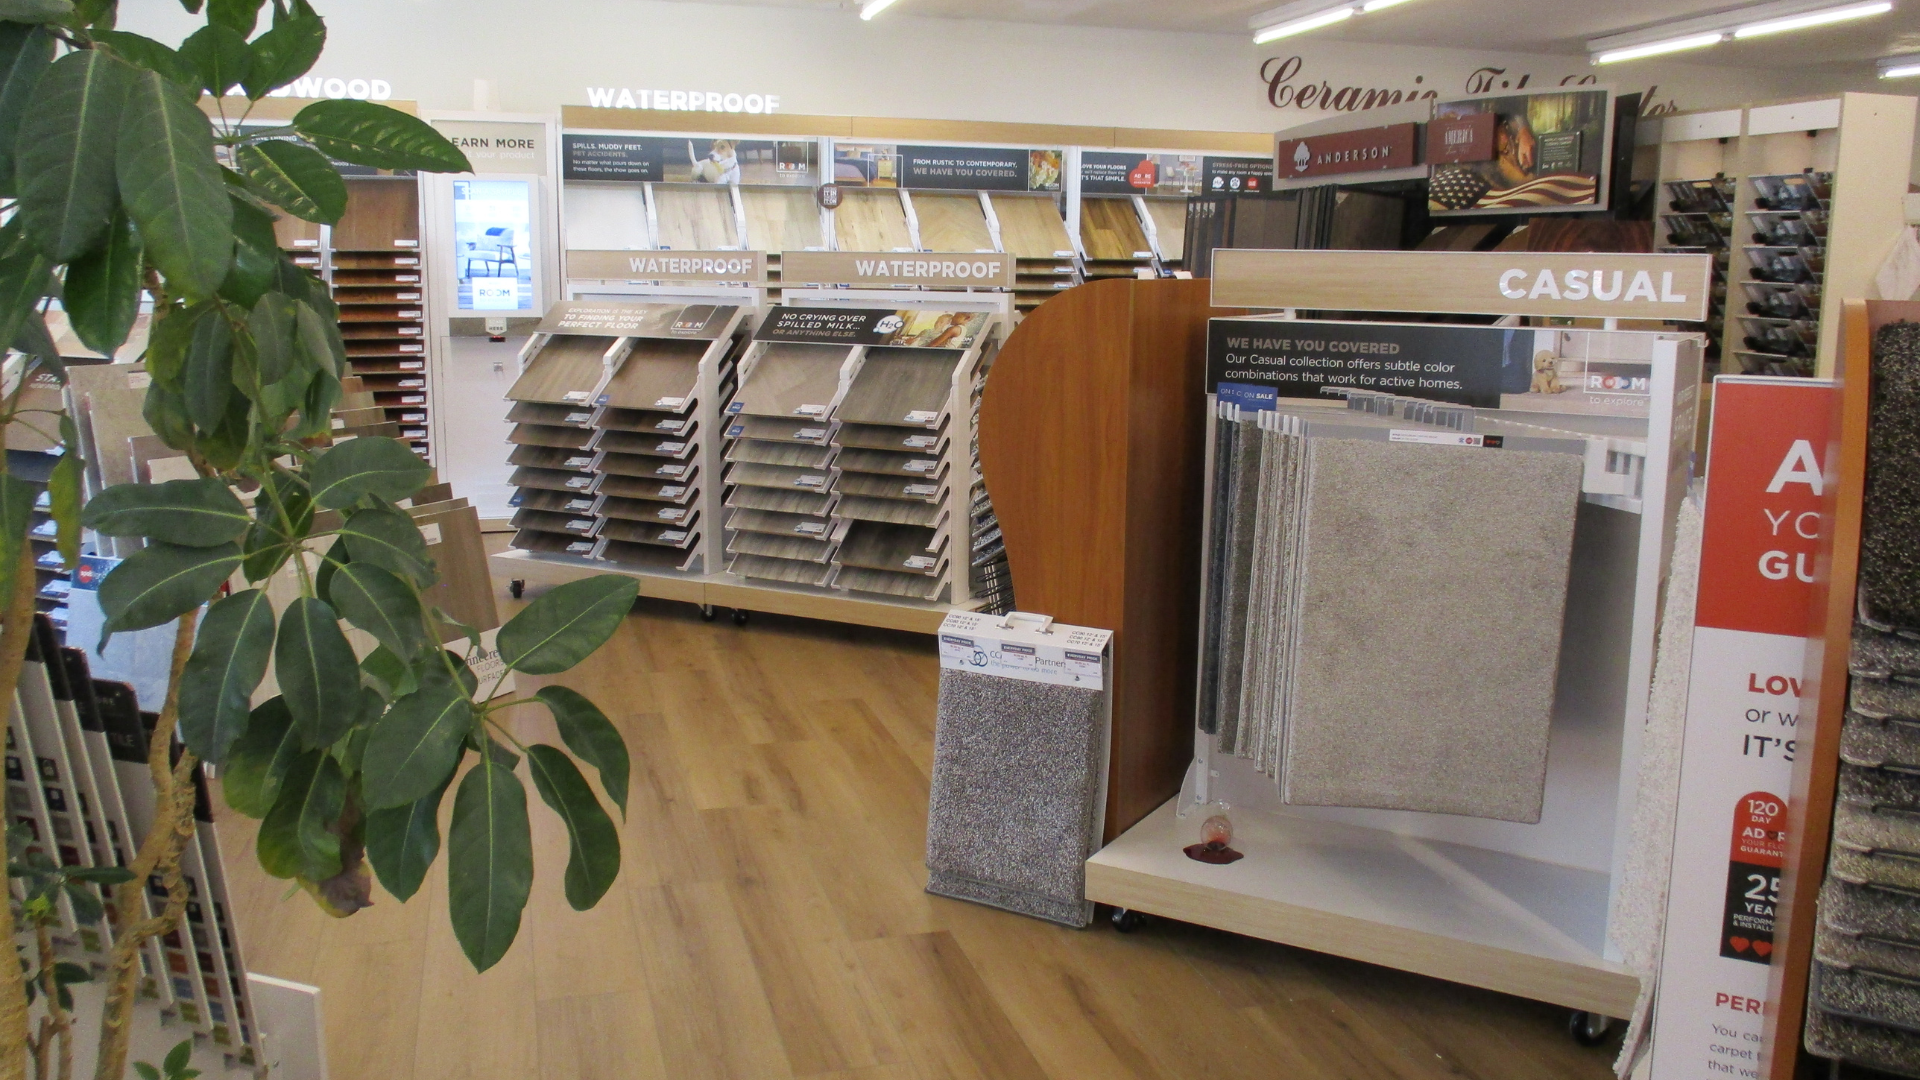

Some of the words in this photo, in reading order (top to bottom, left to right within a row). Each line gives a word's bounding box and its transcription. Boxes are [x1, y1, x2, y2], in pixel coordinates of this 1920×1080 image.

[203, 77, 392, 100] ADWOOD
[587, 87, 780, 114] WATERPROOF
[452, 137, 489, 147] EARN
[496, 139, 535, 149] MORE
[476, 152, 497, 160] your
[501, 152, 535, 160] product
[1317, 146, 1389, 165] ANDERSON
[966, 160, 1018, 168] CONTEMPORARY,
[913, 167, 928, 175] WE
[955, 168, 973, 176] YOU
[975, 170, 1018, 178] COVERED.
[629, 257, 753, 274] WATERPROOF
[855, 260, 1000, 278] WATERPROOF
[1499, 268, 1687, 303] CASUAL
[557, 321, 602, 329] PERFECT
[604, 321, 639, 330] FLOOR
[618, 315, 644, 323] YOUR
[777, 320, 822, 329] SPILLED
[827, 321, 861, 330] MILK...
[799, 314, 836, 322] CRYING
[838, 315, 867, 323] OVER
[1227, 337, 1249, 349] WE
[1253, 339, 1291, 350] HAVE
[1295, 340, 1325, 352] YOU
[1329, 341, 1400, 355] COVERED
[1226, 354, 1247, 365] Our
[1250, 354, 1286, 366] Casual
[1289, 357, 1344, 369] collection
[1347, 359, 1381, 370] offers
[1384, 361, 1421, 372] subtle
[1424, 362, 1456, 374] color
[1225, 369, 1299, 381] combinations
[1302, 372, 1324, 383] that
[1327, 373, 1357, 385] work
[1360, 374, 1377, 386] for
[1379, 376, 1416, 387] active
[1418, 377, 1463, 390] homes.
[1590, 375, 1647, 390] ROOM
[1590, 396, 1601, 404] to
[1603, 397, 1645, 406] explore
[479, 669, 504, 685] URFACE
[1745, 708, 1771, 723] or
[1742, 734, 1795, 762] IT'S
[1747, 799, 1779, 817] 120
[1751, 815, 1772, 825] DAY
[1741, 838, 1765, 847] YOUR
[1744, 873, 1780, 903] 25
[1715, 992, 1765, 1017] PER
[1712, 1023, 1737, 1038] You
[1709, 1043, 1753, 1060] carpet
[1708, 1059, 1735, 1075] that
